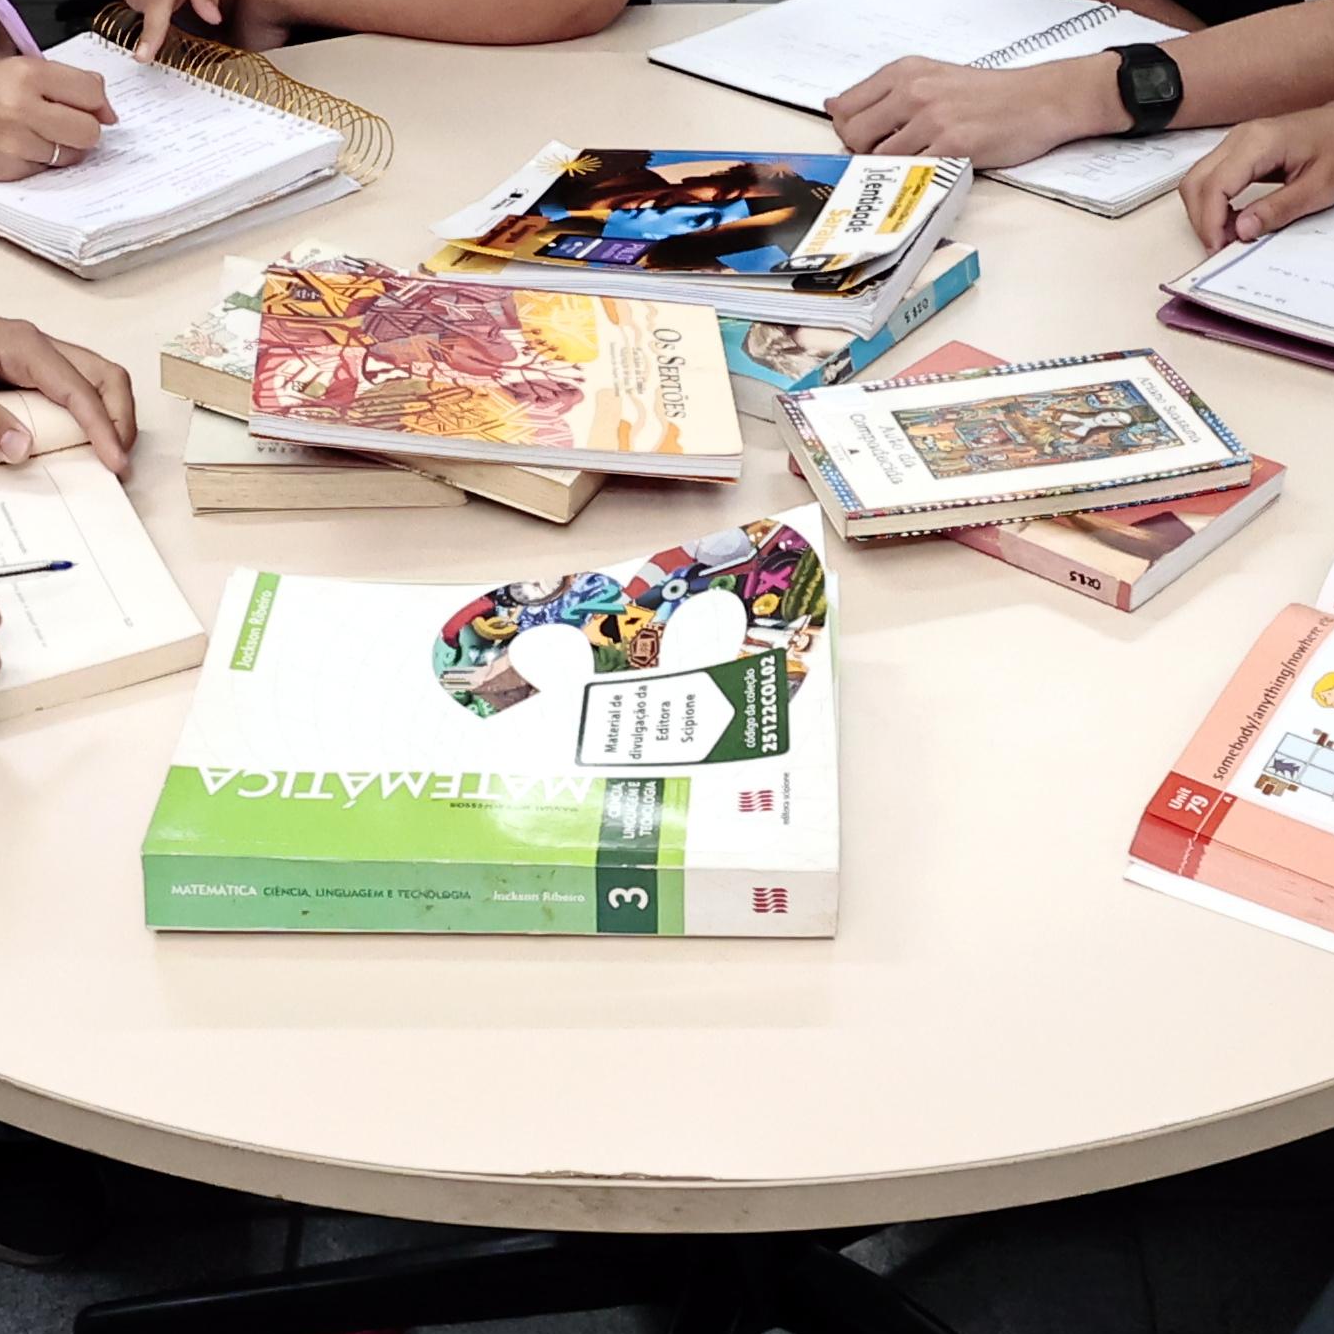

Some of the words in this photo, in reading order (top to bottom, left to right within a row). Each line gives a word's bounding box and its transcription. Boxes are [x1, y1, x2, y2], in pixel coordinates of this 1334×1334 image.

[878, 425, 905, 451] Auto
[898, 454, 916, 468] da
[248, 590, 272, 625] Ribeiro
[236, 628, 262, 668] Jackson
[610, 694, 623, 708] de
[635, 685, 648, 700] da
[744, 668, 758, 703] coleção
[681, 694, 696, 743] Scipione
[744, 704, 756, 717] da
[760, 654, 779, 753] 25122COL02
[604, 709, 622, 753] Material
[629, 701, 648, 760] divulgação
[656, 701, 671, 742] Editora
[742, 717, 758, 748] código
[195, 766, 594, 809] MATEMÁTICA
[1168, 787, 1192, 810] Unit
[781, 801, 790, 825] editora
[1184, 795, 1209, 815] 79
[315, 886, 384, 899] LINGUAGEM
[387, 889, 393, 898] E
[397, 888, 471, 900] TECNOLOGIA
[492, 891, 539, 902] Jackson
[608, 887, 648, 911] 3
